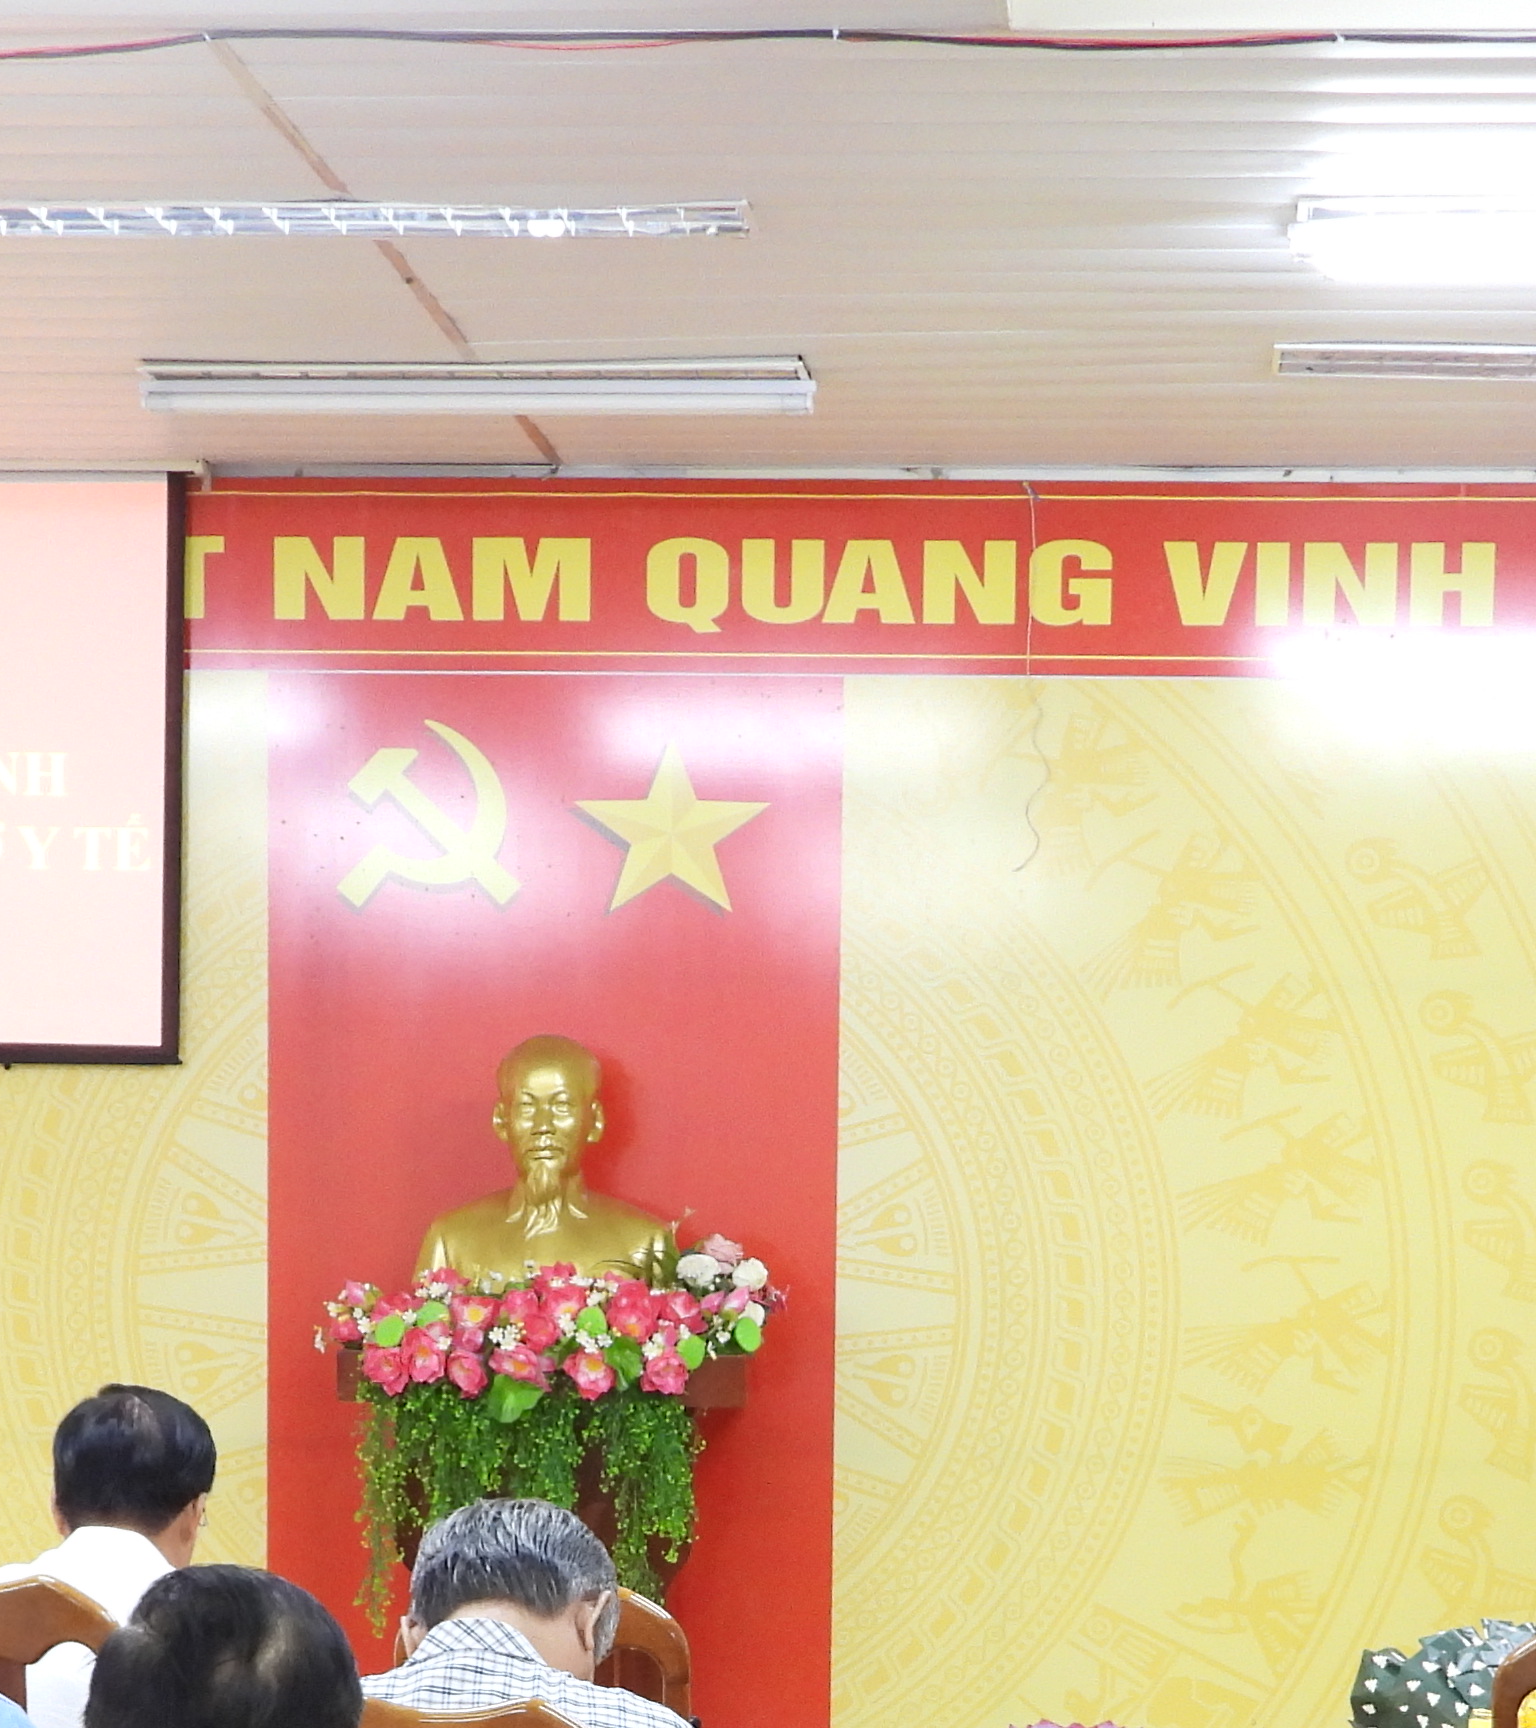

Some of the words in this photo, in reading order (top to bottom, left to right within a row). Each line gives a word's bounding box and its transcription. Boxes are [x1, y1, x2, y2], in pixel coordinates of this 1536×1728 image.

[273, 536, 592, 622] NAM
[645, 536, 1114, 632] QUANG
[1163, 539, 1497, 630] VINH
[18, 826, 59, 870] Y
[73, 812, 152, 872] TẾ
